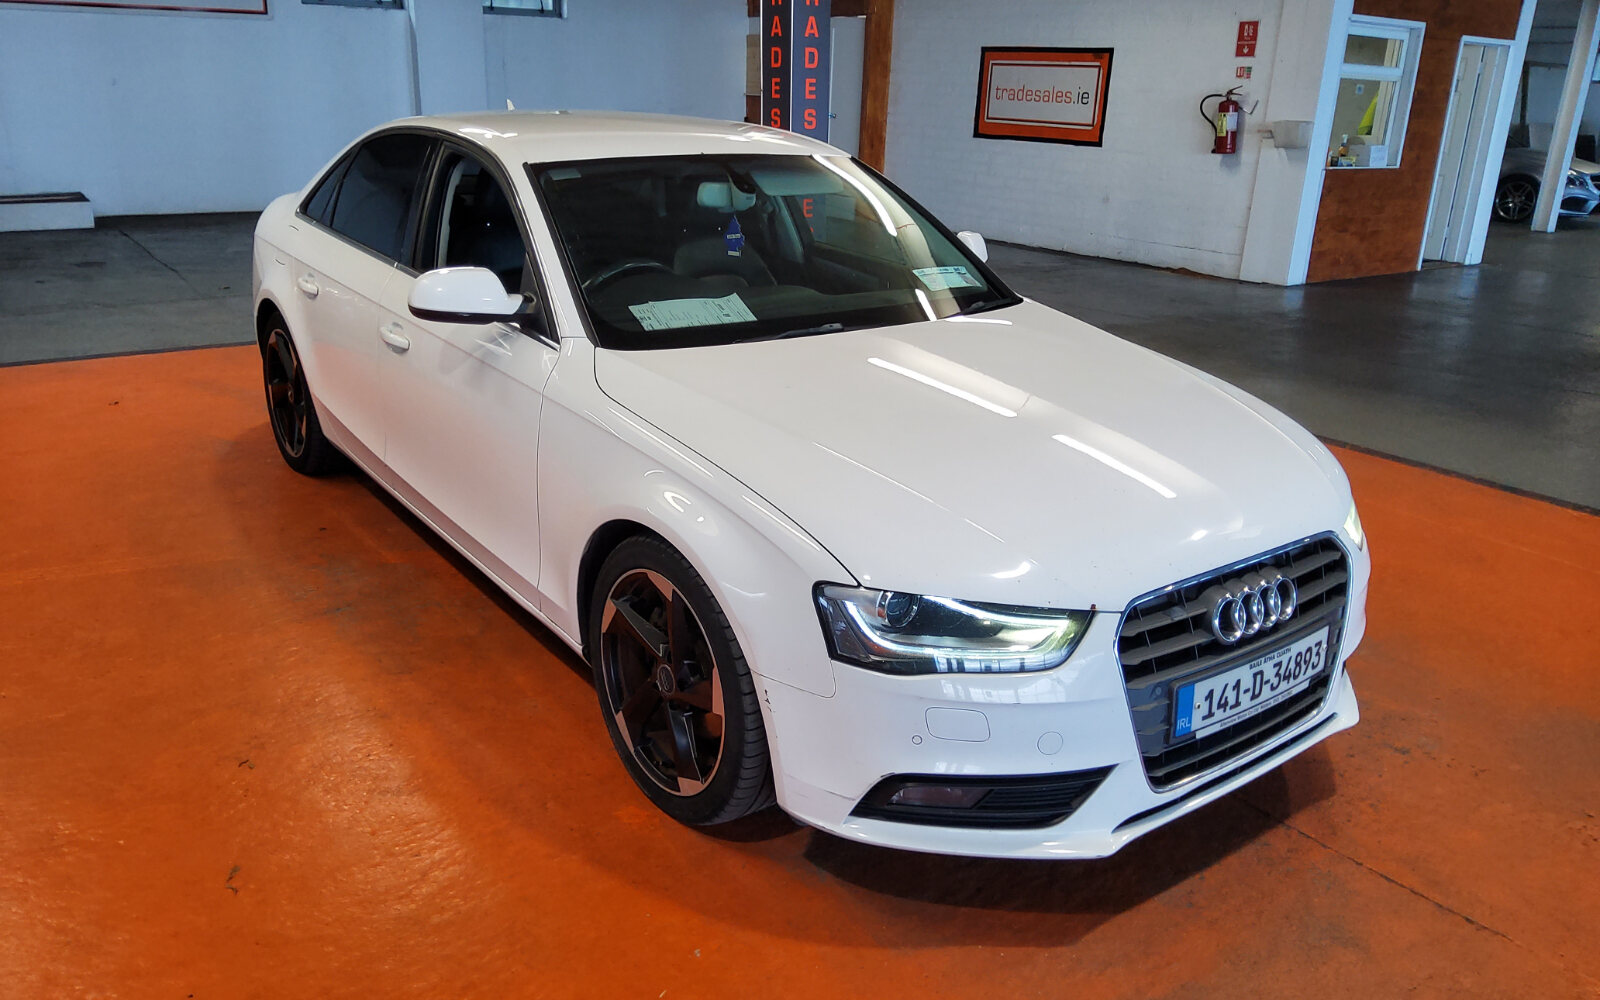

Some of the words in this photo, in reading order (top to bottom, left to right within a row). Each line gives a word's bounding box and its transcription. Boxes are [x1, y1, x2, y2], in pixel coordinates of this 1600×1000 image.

[770, 0, 782, 128] ADES
[803, 0, 819, 130] ADES
[995, 84, 1090, 105] tradesales.ie
[1202, 640, 1323, 721] 141-D-34893
[1177, 717, 1191, 731] IRL
